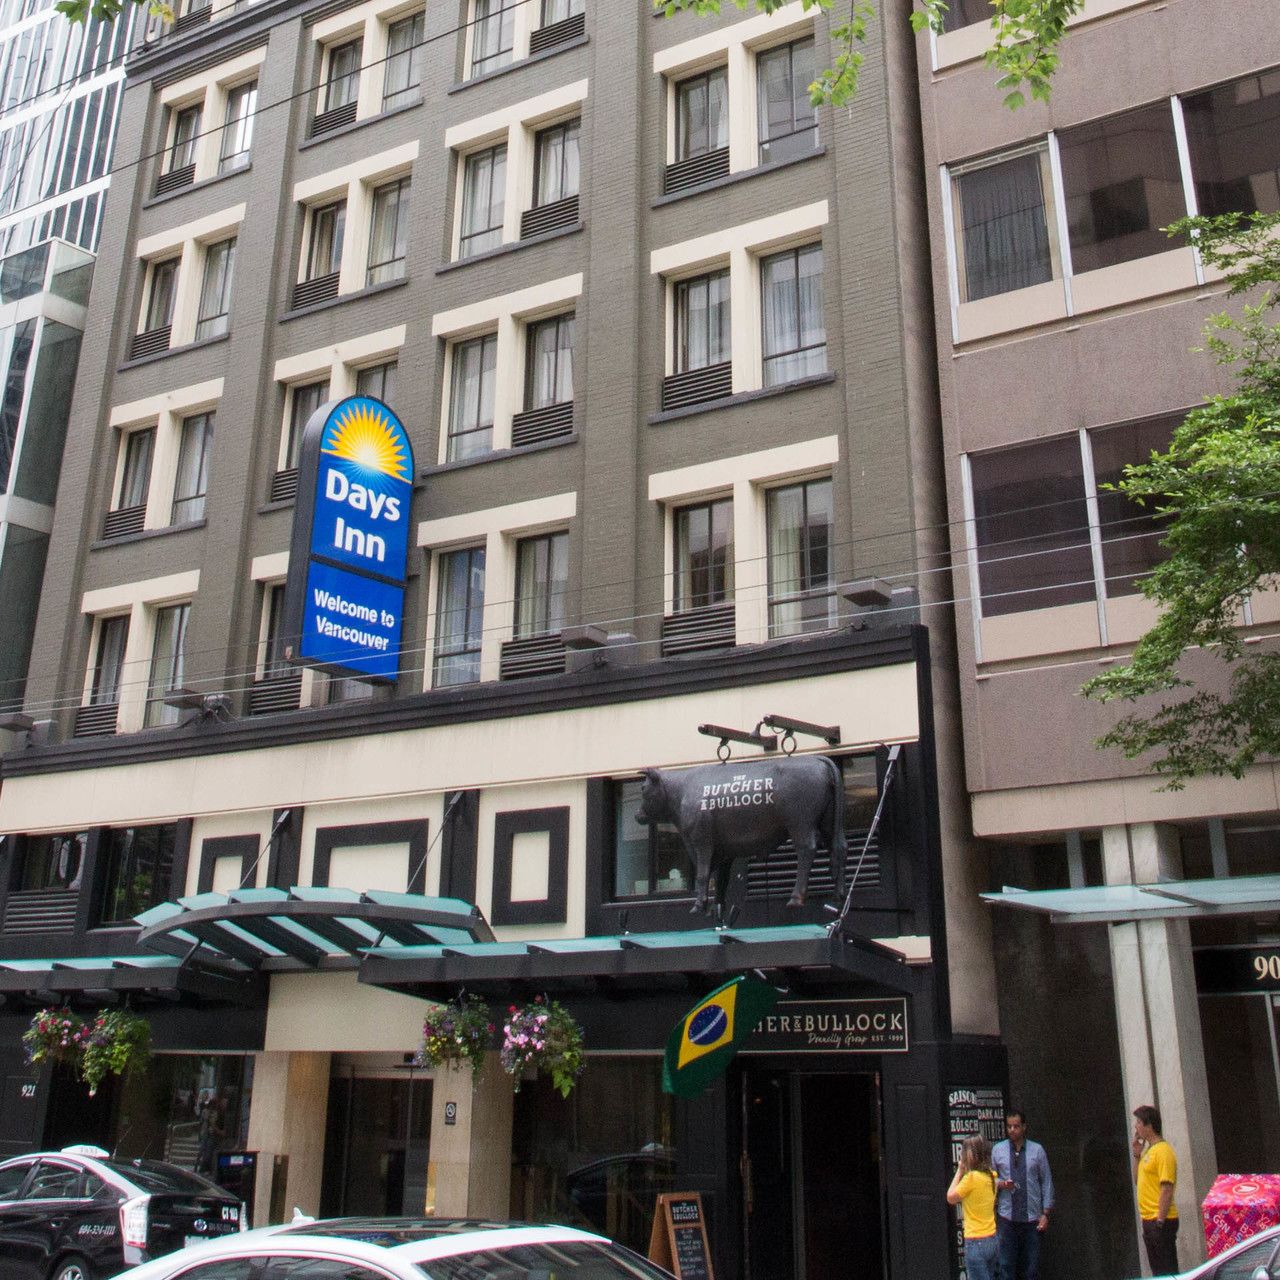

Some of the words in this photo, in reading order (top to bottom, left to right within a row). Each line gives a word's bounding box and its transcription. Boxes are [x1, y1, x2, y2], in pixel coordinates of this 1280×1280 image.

[326, 468, 400, 521] Days
[334, 516, 386, 562] Inn
[314, 588, 378, 623] Welcome
[381, 609, 395, 628] to
[316, 614, 389, 651] Vancouver
[703, 777, 775, 797] BUTCHER
[709, 792, 775, 811] BULLOCK
[804, 1012, 903, 1032] BULLOCK
[845, 1032, 867, 1046] Group
[21, 1084, 36, 1097] 921
[977, 1108, 993, 1120] DARK
[994, 1108, 1005, 1119] ALE
[950, 1117, 979, 1133] KÖLSCH
